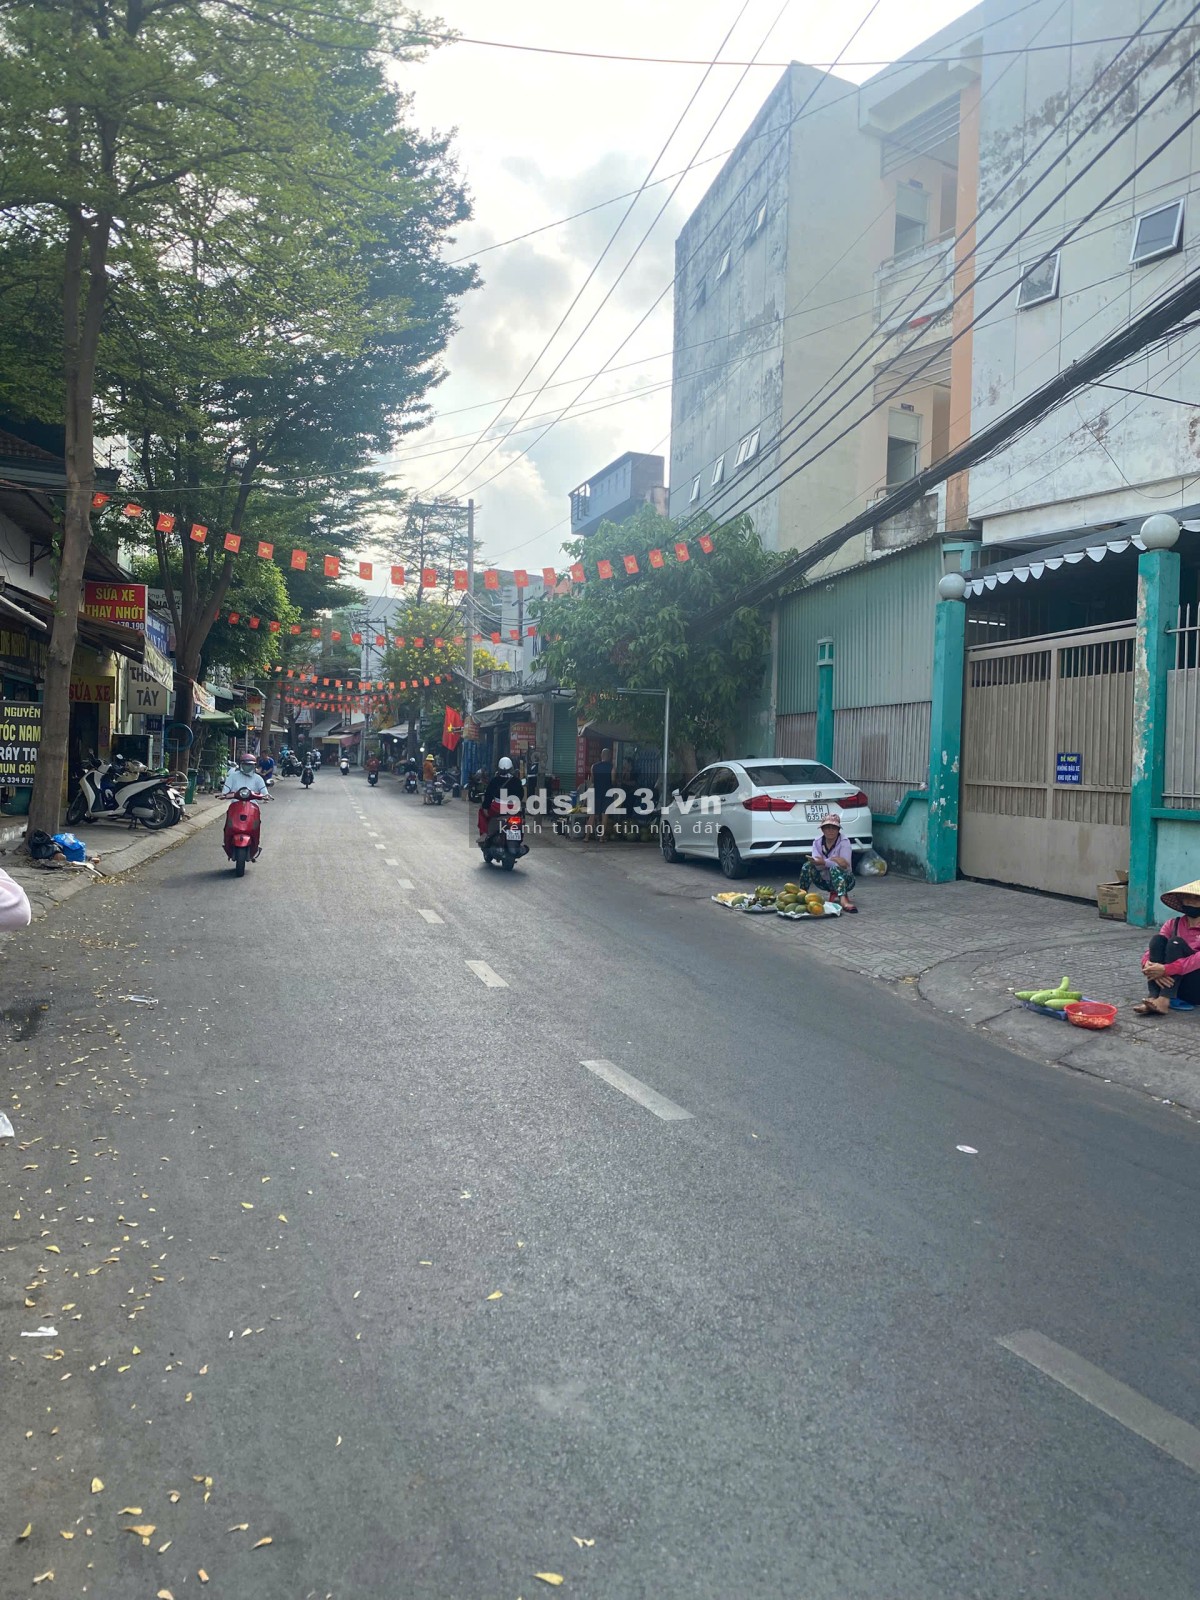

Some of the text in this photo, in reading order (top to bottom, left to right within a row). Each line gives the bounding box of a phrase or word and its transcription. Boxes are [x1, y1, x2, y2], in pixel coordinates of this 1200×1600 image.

[96, 585, 117, 600] SỬA
[121, 589, 135, 601] XE
[85, 604, 144, 619] THAY NHỚT
[95, 685, 111, 701] XE
[136, 687, 159, 706] TÂY
[4, 705, 40, 718] NGUYỄN
[19, 725, 41, 742] NAM
[23, 748, 39, 761] TA
